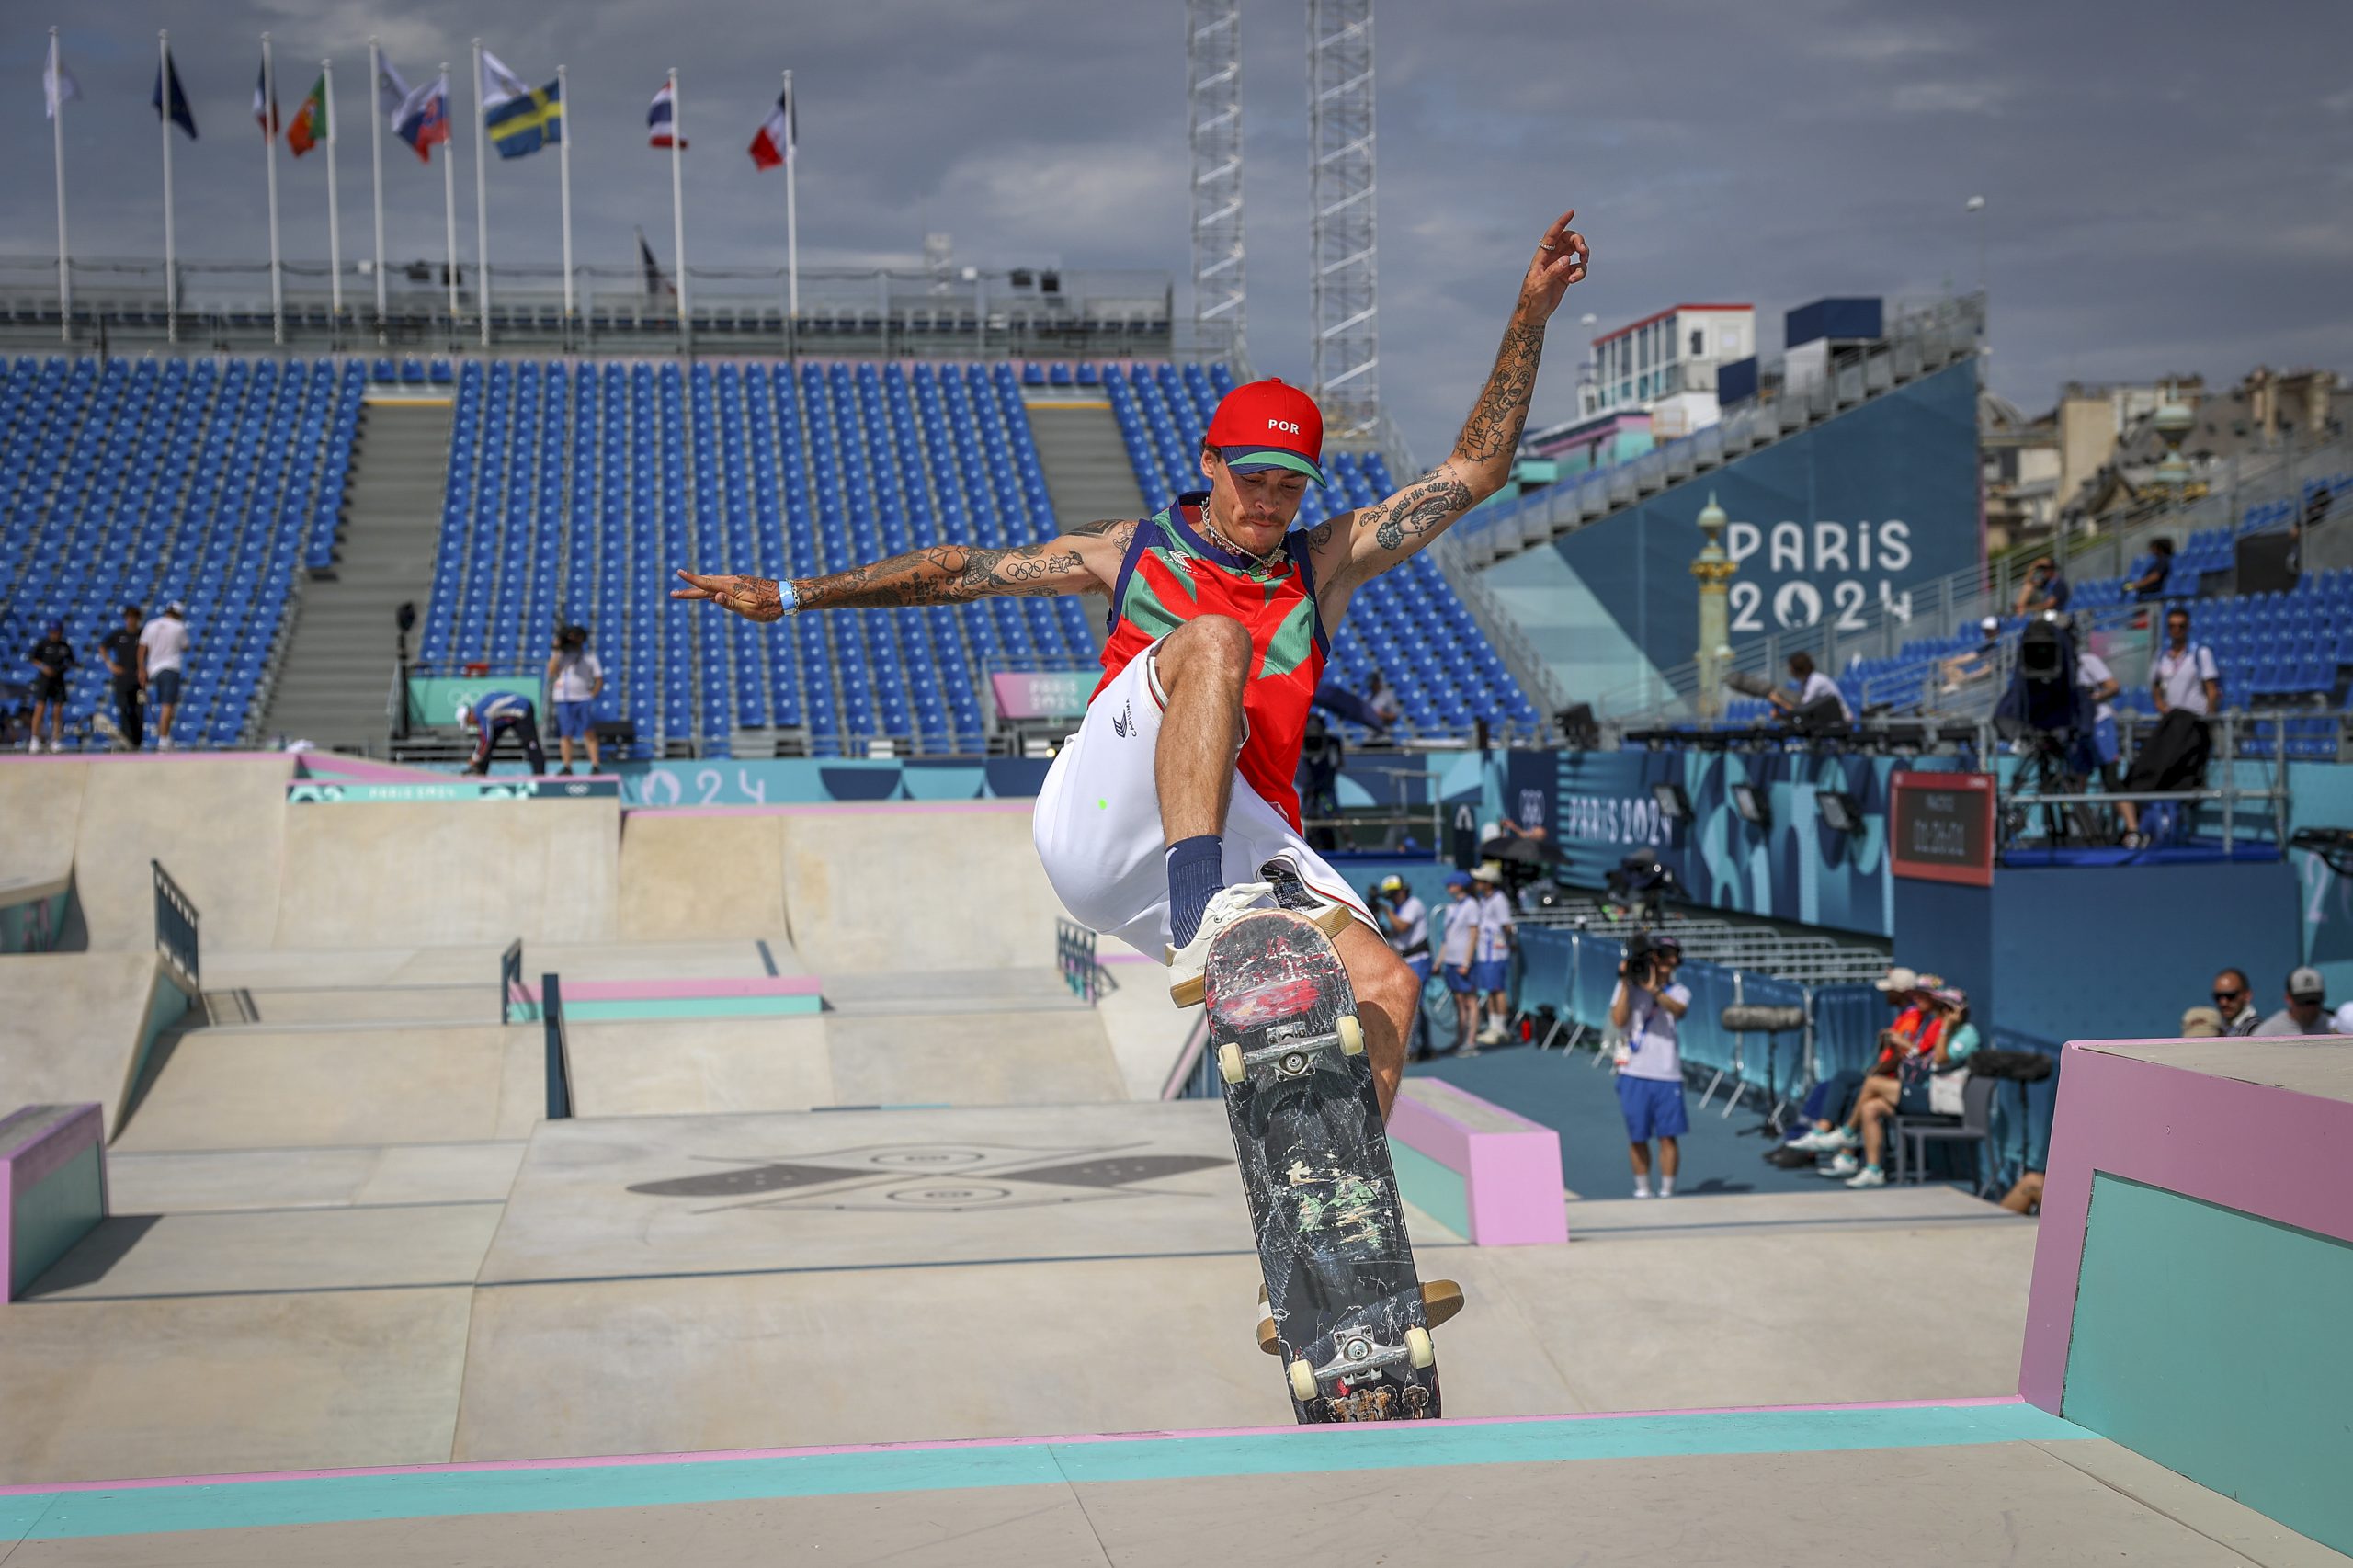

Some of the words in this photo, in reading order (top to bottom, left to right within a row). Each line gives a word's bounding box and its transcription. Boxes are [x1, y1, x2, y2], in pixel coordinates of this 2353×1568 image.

[1268, 418, 1300, 435] POR
[1729, 579, 1913, 632] 2024
[1126, 697, 1137, 737] CARIUMA
